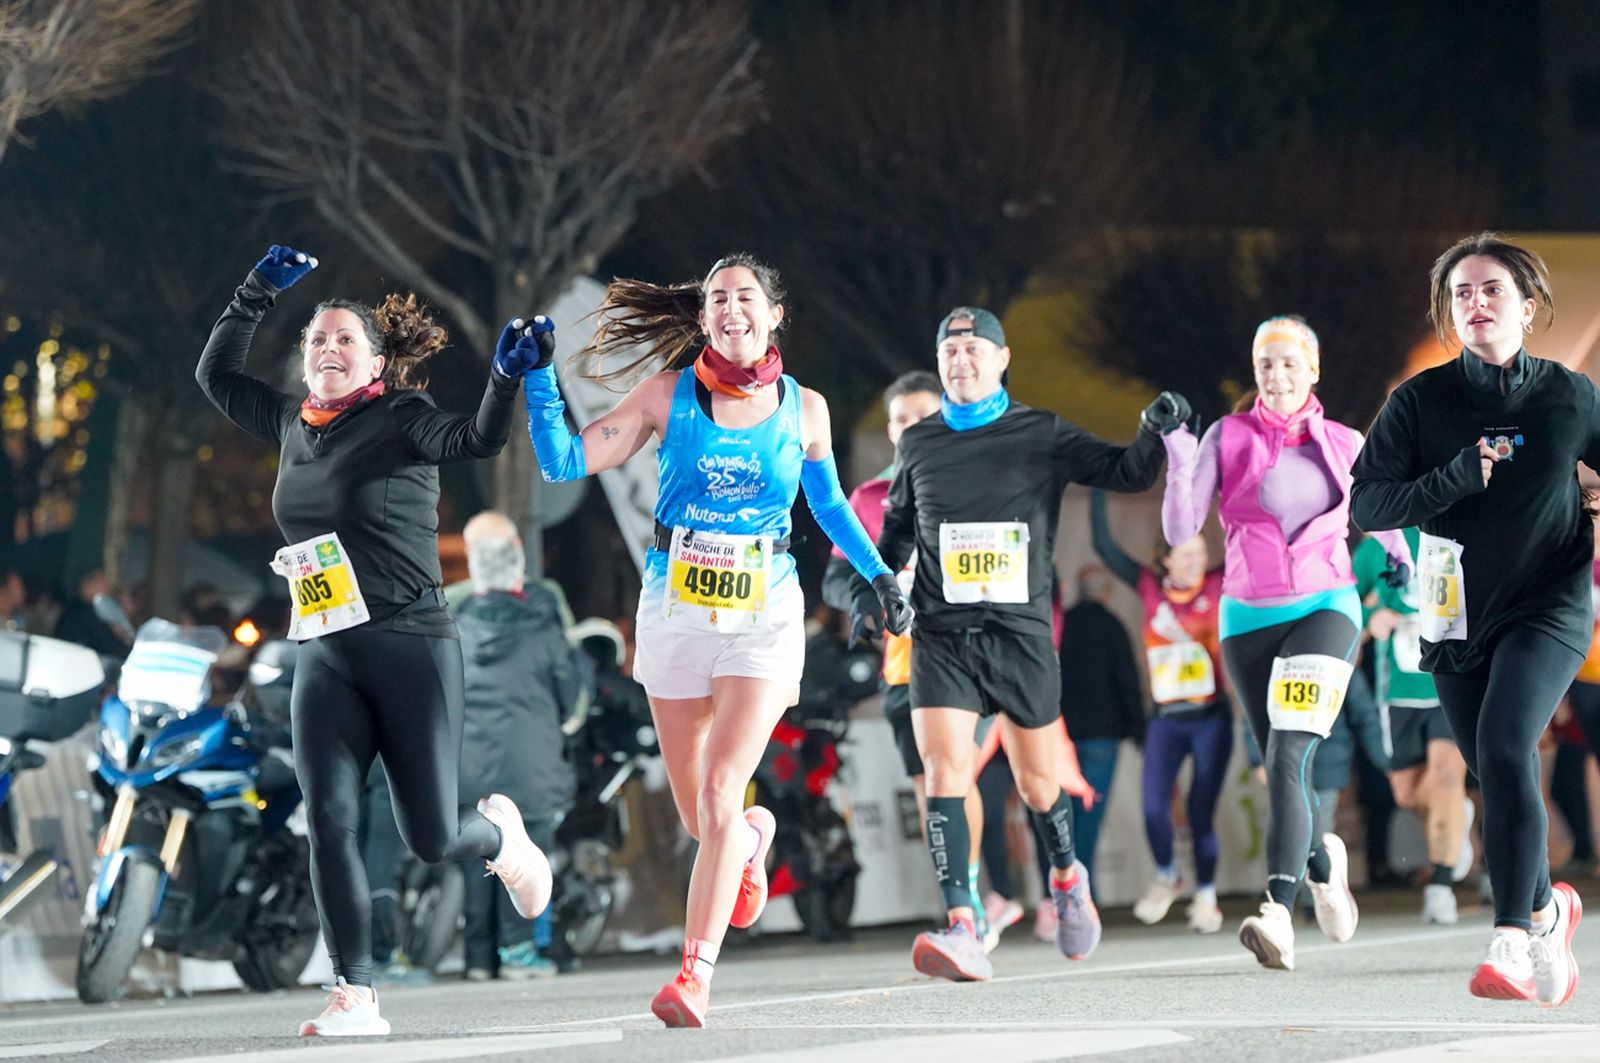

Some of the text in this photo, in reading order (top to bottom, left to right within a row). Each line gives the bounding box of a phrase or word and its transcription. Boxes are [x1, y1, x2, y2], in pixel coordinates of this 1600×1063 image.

[707, 467, 736, 490] 25
[692, 541, 721, 555] NOCHE
[723, 546, 736, 556] DE
[297, 553, 308, 565] DE
[680, 551, 698, 564] SAN
[699, 554, 735, 568] ANTÓN
[959, 552, 1009, 575] 9186
[684, 566, 752, 600] 4980
